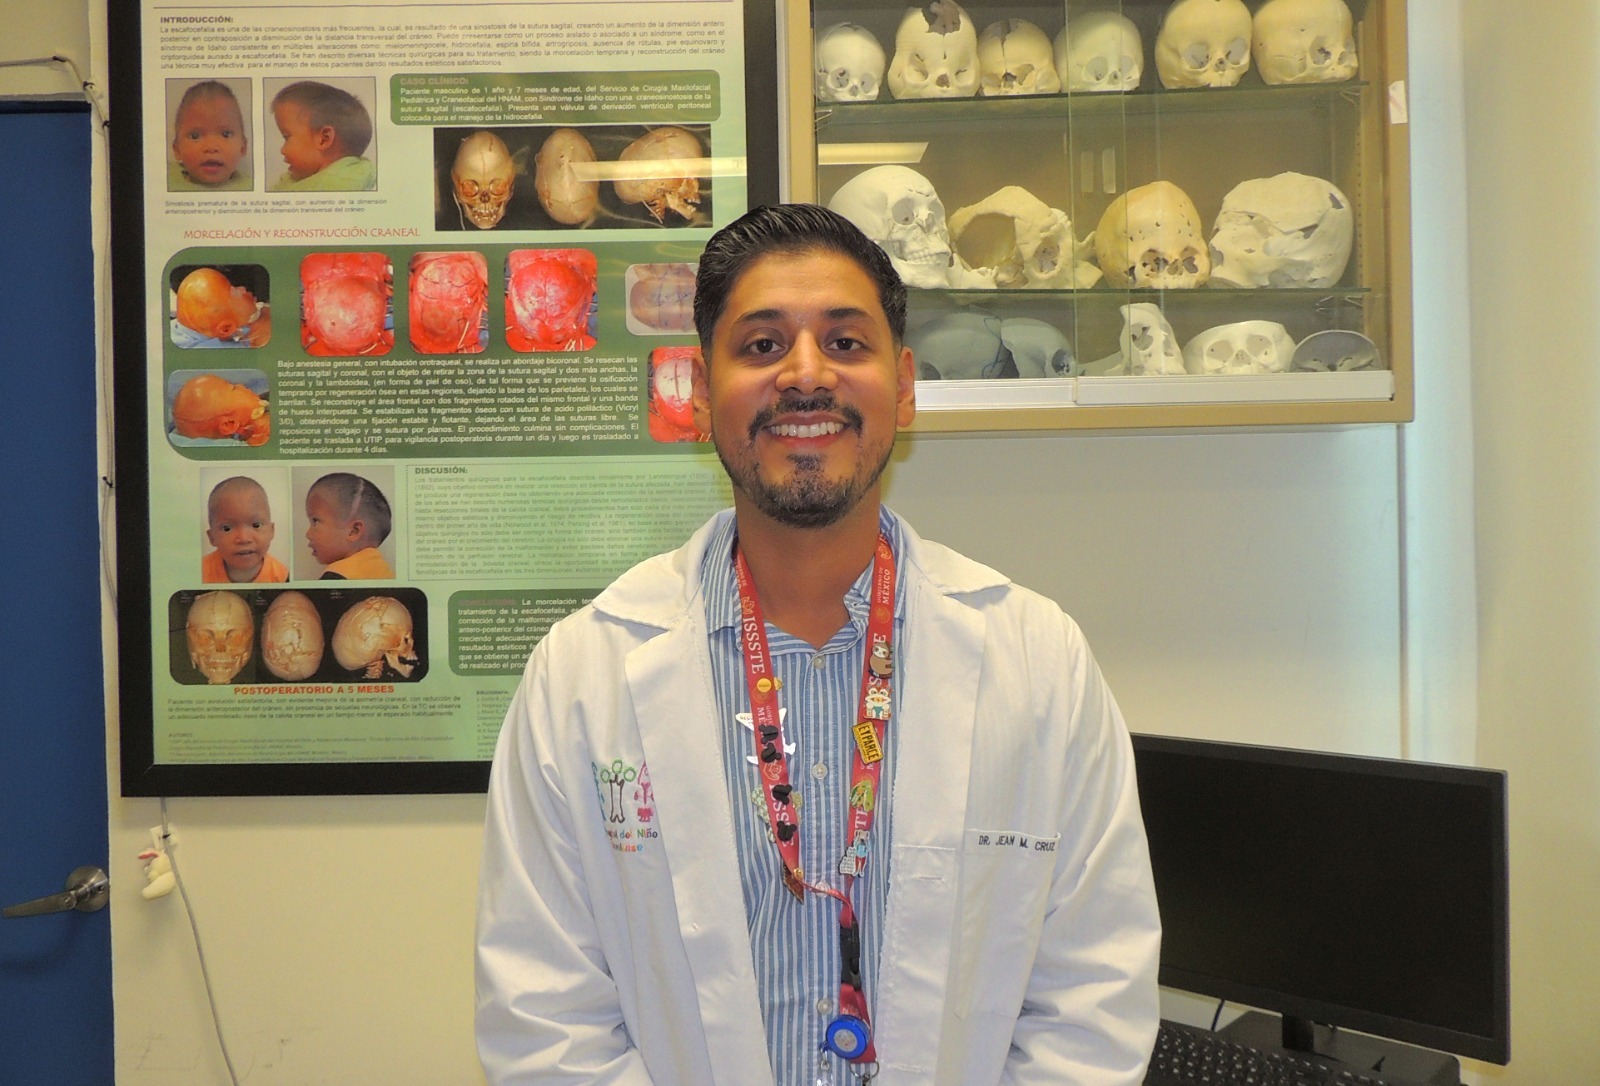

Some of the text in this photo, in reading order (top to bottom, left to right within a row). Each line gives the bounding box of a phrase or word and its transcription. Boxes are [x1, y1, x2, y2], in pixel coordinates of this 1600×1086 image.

[401, 87, 430, 95] Paciente
[433, 87, 468, 95] masculino
[600, 85, 627, 93] Servicio
[642, 84, 668, 94] Cirugía
[671, 84, 712, 92] Maxilofacial
[401, 114, 431, 122] colocada
[458, 114, 484, 123] manejo
[184, 227, 421, 239] MORCELACIÓN Y RECONSTRUCCIÓN CRANEAL
[278, 359, 294, 369] Bajo
[296, 359, 332, 368] anestesia
[380, 358, 418, 367] intubación
[475, 357, 500, 366] realiza
[513, 356, 545, 367] abordaje
[584, 356, 594, 365] Se
[626, 355, 638, 364] las
[310, 397, 321, 406] Se
[323, 397, 366, 407] reconstruye
[368, 396, 376, 405] el
[378, 396, 395, 405] área
[397, 396, 420, 405] frontal
[438, 395, 452, 404] dos
[454, 395, 495, 406] fragmentos
[497, 395, 525, 404] rotados
[527, 394, 539, 403] del
[540, 395, 565, 403] mismo
[567, 394, 590, 403] frontal
[592, 396, 597, 404] y
[615, 393, 639, 402] banda
[279, 407, 288, 416] de
[291, 406, 314, 415] hueso
[362, 406, 373, 415] Se
[375, 406, 415, 415] estabilizan
[417, 405, 428, 414] los
[431, 405, 472, 416] fragmentos
[475, 405, 497, 414] óseos
[516, 405, 539, 414] sutura
[542, 404, 551, 413] de
[615, 404, 639, 414] (Vicryl
[280, 445, 333, 456] hospitalización
[335, 445, 363, 454] durante
[364, 445, 369, 454] 4
[882, 569, 890, 604] MÉXICO
[536, 598, 577, 606] morcelación
[459, 626, 512, 635] antero-posterior
[743, 617, 765, 674] ISSSTE
[858, 725, 879, 761] EYPARCE
[620, 829, 632, 839] del
[637, 827, 659, 839] Niño
[996, 836, 1015, 846] JEAN
[1035, 842, 1055, 851] CRUZ
